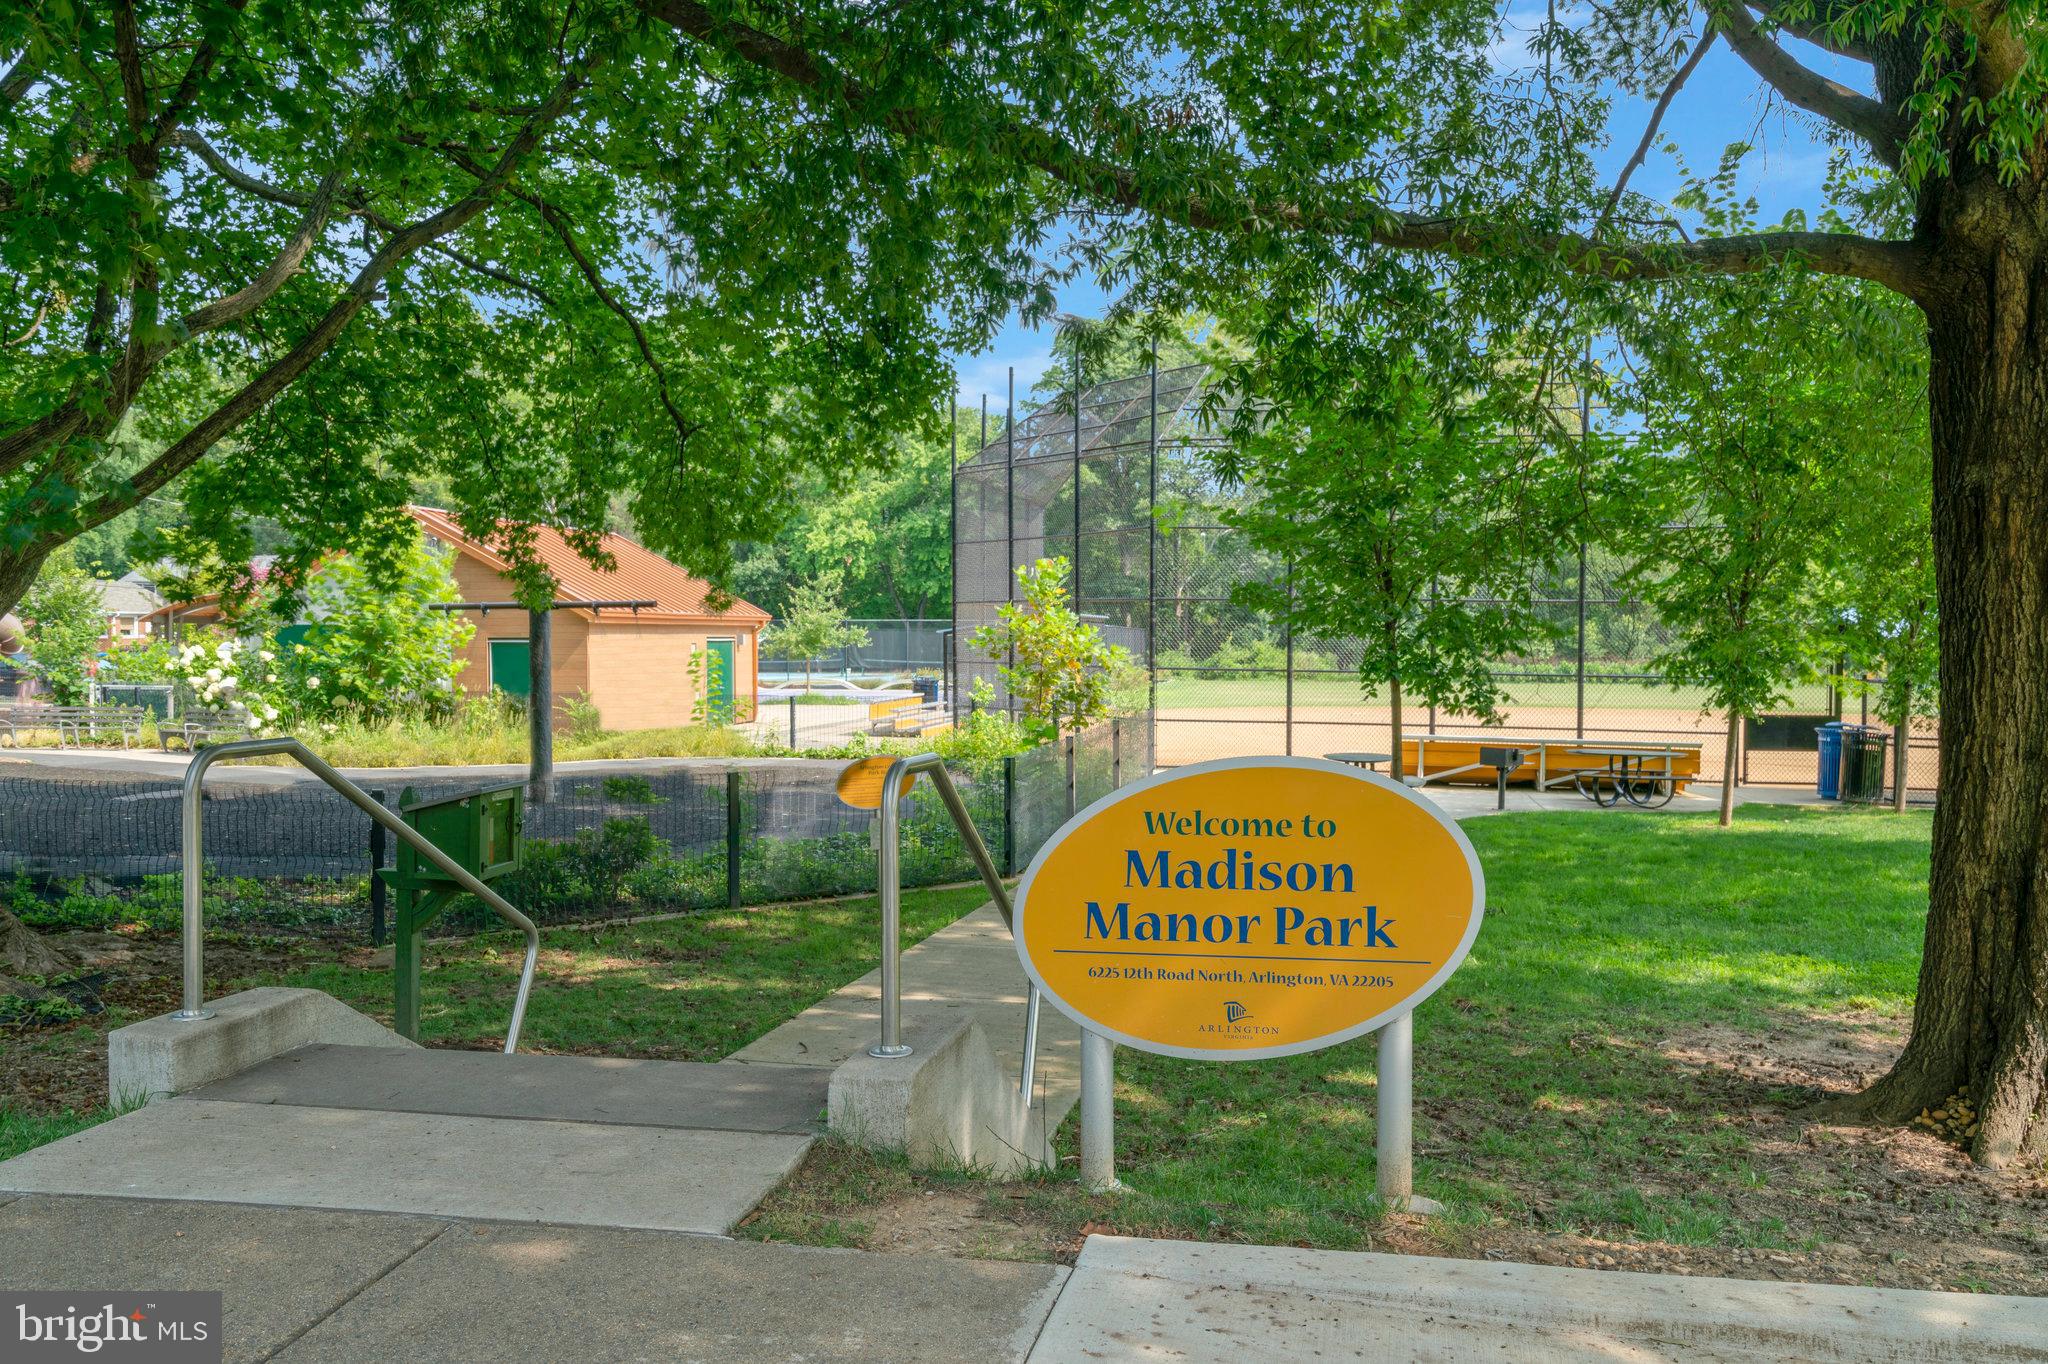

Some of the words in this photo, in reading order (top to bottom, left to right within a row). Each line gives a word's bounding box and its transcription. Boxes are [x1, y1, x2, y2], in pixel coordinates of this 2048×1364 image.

[1144, 810, 1293, 839] Welcome
[1302, 814, 1337, 839] to
[1123, 848, 1356, 893] Madison
[1084, 901, 1261, 944] Manor
[1273, 905, 1399, 949] Park
[1088, 966, 1120, 979] 6225
[1123, 967, 1153, 980] 12th
[1157, 968, 1195, 981] Road
[1198, 969, 1246, 984] North,
[1248, 970, 1328, 988] Arlington,
[1329, 974, 1349, 987] VA
[1351, 975, 1394, 988] 22205
[1198, 1024, 1280, 1035] ARLINGTON
